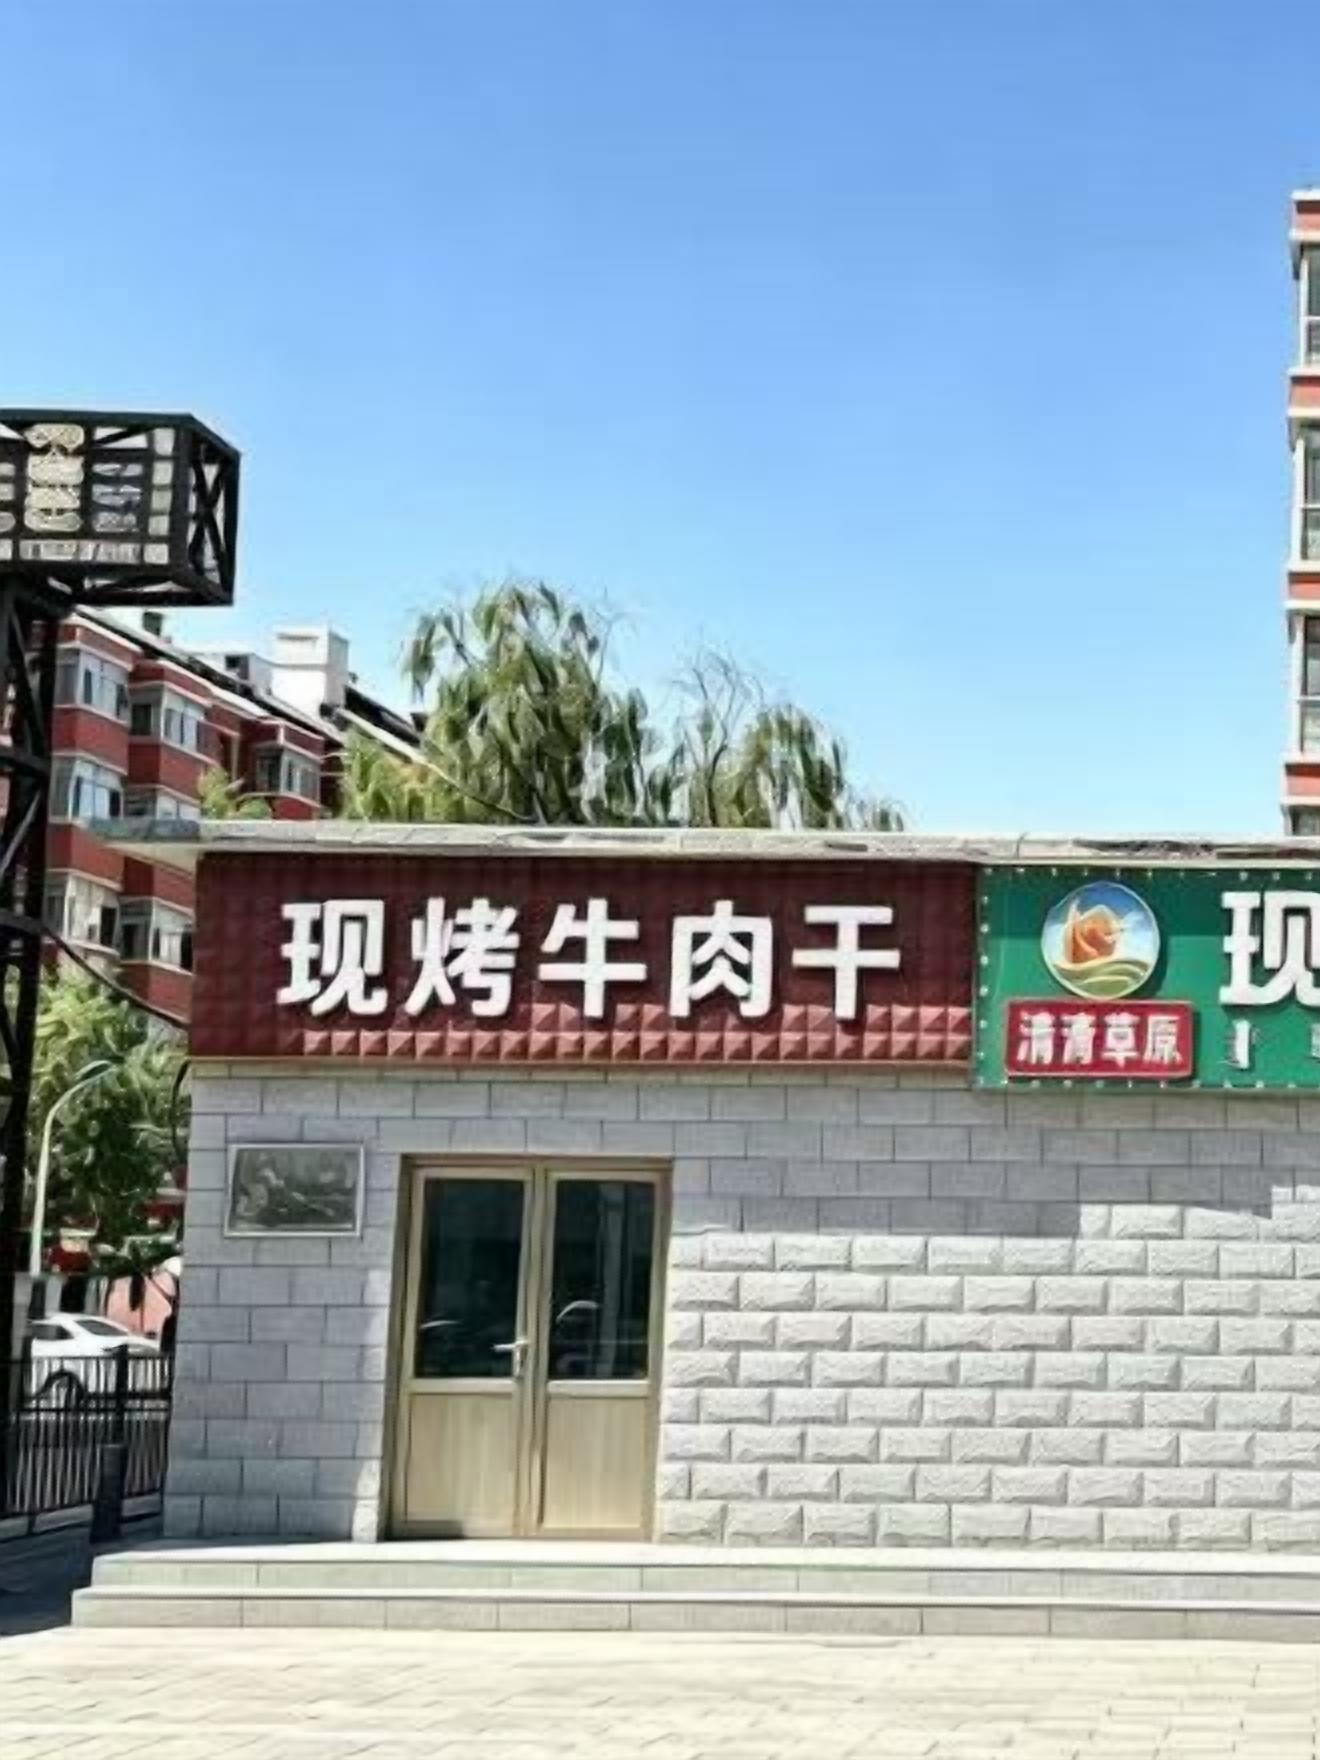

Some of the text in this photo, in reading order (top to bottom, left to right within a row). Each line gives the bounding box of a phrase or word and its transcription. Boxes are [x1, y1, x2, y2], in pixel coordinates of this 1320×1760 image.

[277, 897, 901, 1021] 现烤牛肉干
